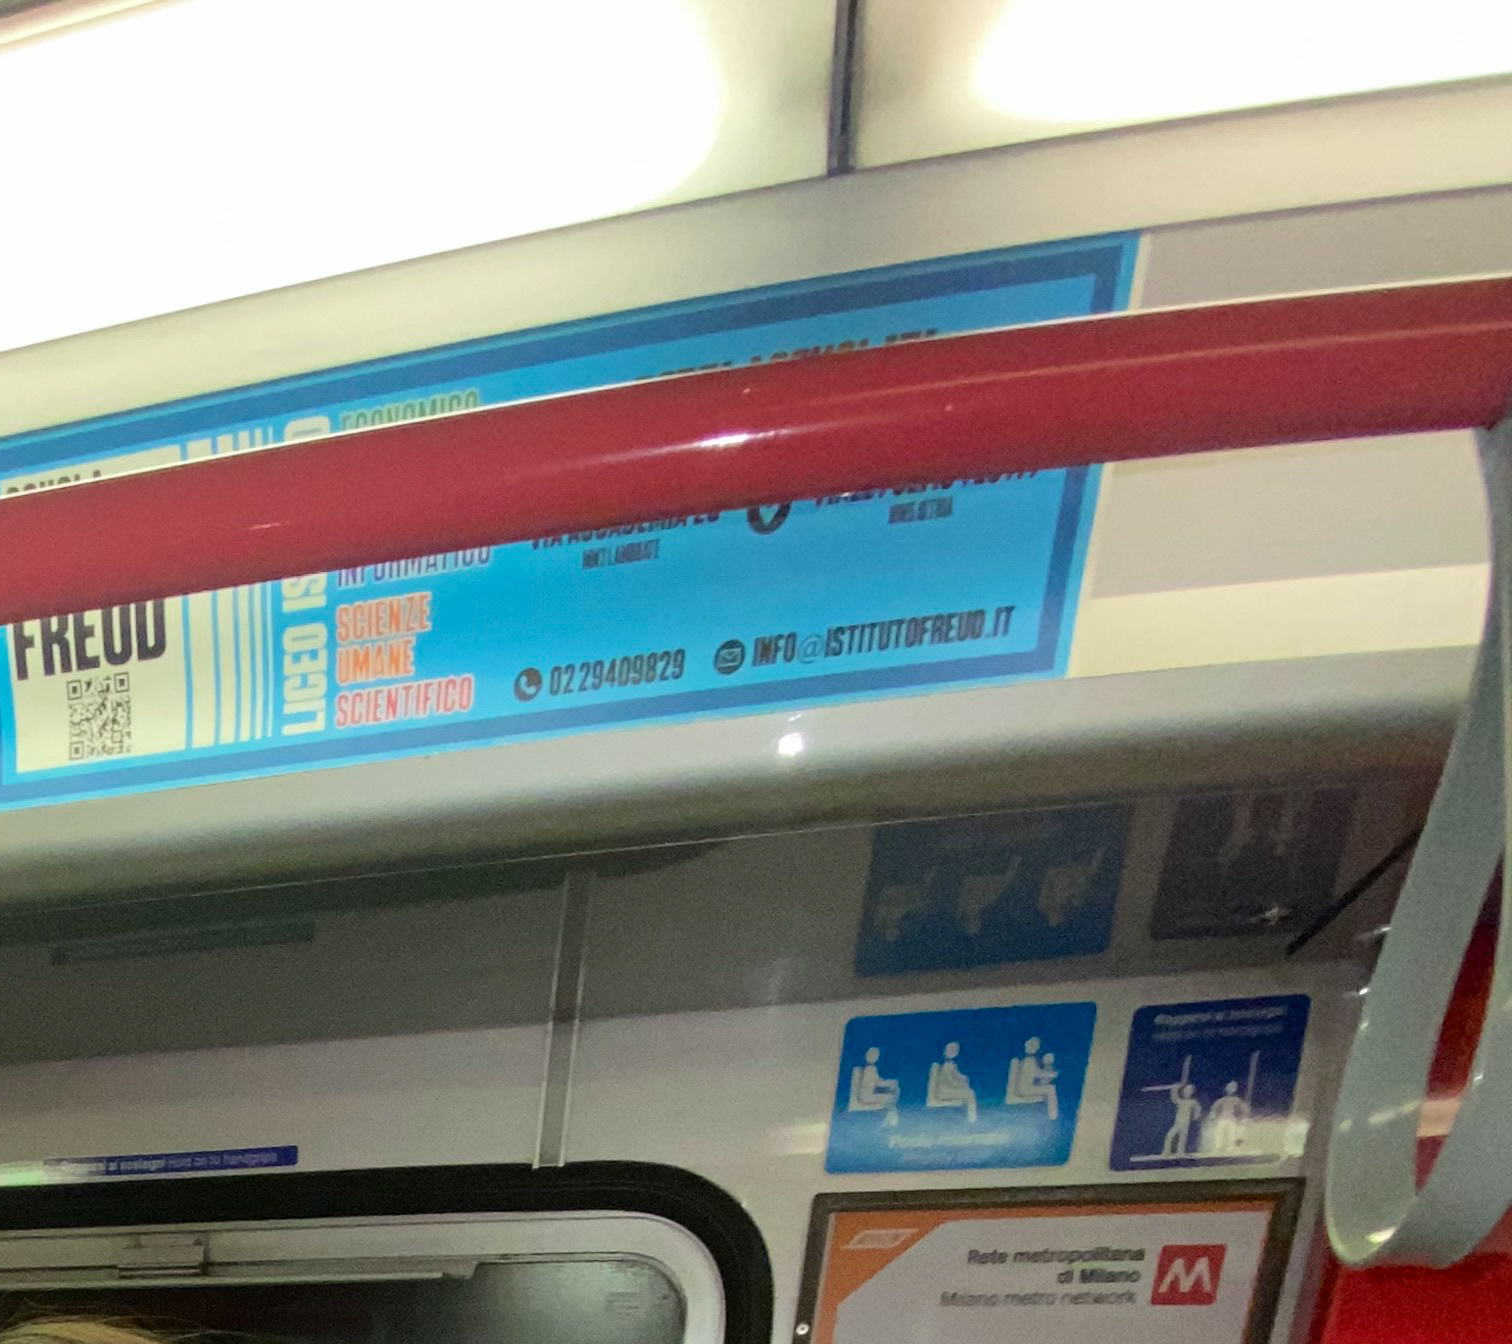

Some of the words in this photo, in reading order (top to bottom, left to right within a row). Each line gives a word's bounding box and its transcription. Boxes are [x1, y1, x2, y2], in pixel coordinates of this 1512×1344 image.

[13, 598, 167, 681] FREUD
[336, 592, 431, 643] SCIENZE
[282, 622, 327, 736] LICEO
[336, 638, 415, 684] UMANE
[336, 674, 474, 728] SCIENTIFICO
